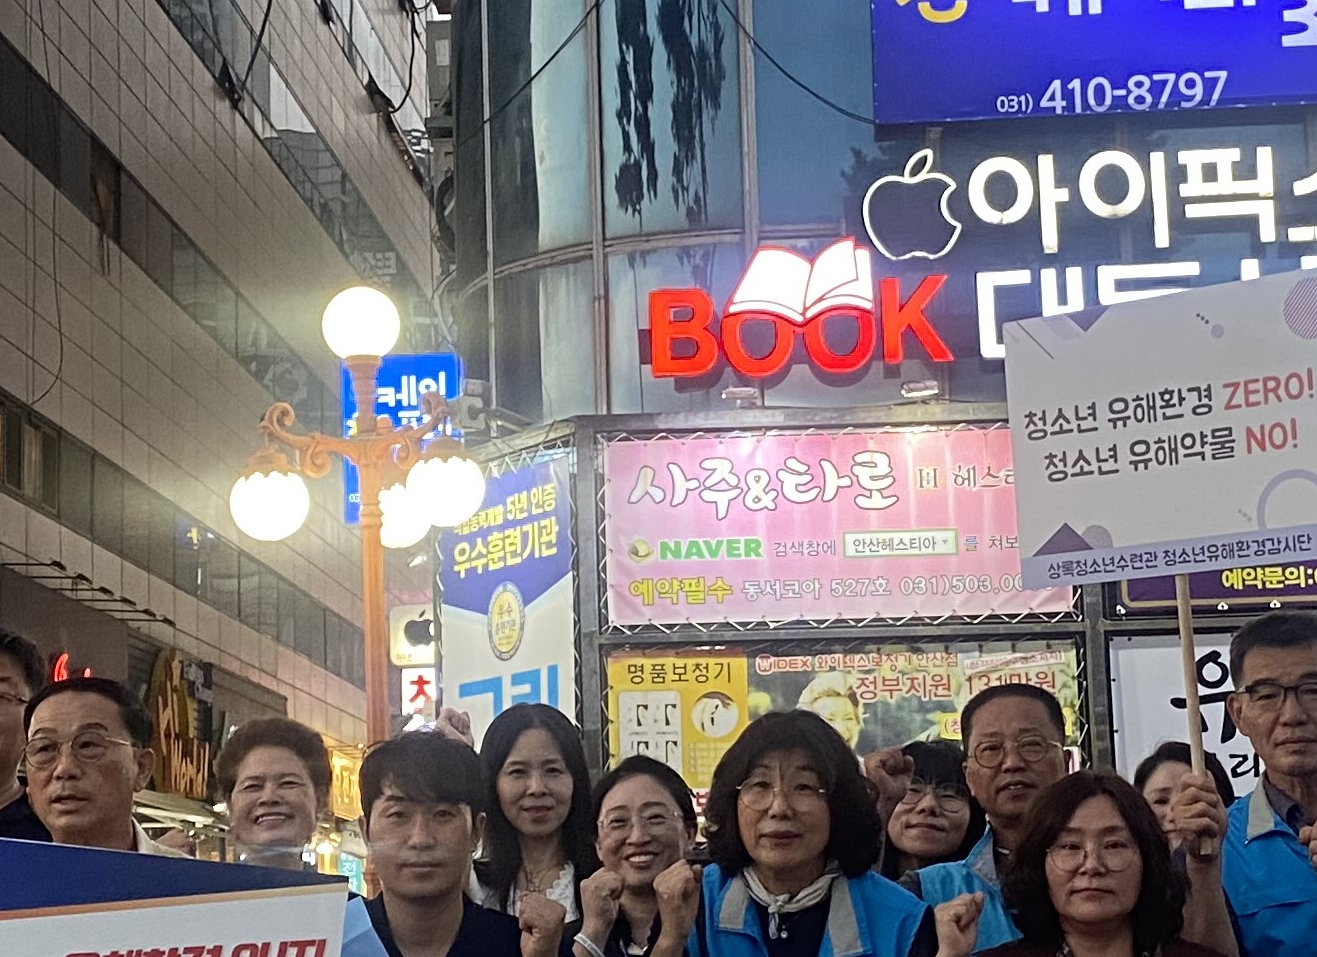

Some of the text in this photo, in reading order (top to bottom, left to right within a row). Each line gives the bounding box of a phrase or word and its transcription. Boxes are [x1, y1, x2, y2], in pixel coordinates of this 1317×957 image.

[996, 70, 1229, 115] 031) 410-8797
[650, 272, 955, 380] BOOK
[1023, 366, 1316, 442] 청소년 유해환경 ZERO!
[1043, 417, 1299, 484] 청소년 유해약물 NO!
[506, 490, 528, 520] 5년
[530, 482, 556, 515] 인증
[628, 450, 899, 521] 사주&타로
[453, 515, 559, 579] 우수훈련기관
[659, 537, 764, 560] NAVER
[772, 540, 837, 558] 검색창에
[853, 536, 937, 554] 안산헤스티아
[1047, 531, 1313, 581] 상록청소년수련관 청소년유해환경감시단
[628, 576, 733, 606] 예약필수
[741, 577, 823, 603] 동서코아
[829, 575, 892, 598] 527호
[755, 654, 811, 675] WIDEX
[916, 652, 959, 669] 안산점
[854, 673, 953, 701] 정부지원
